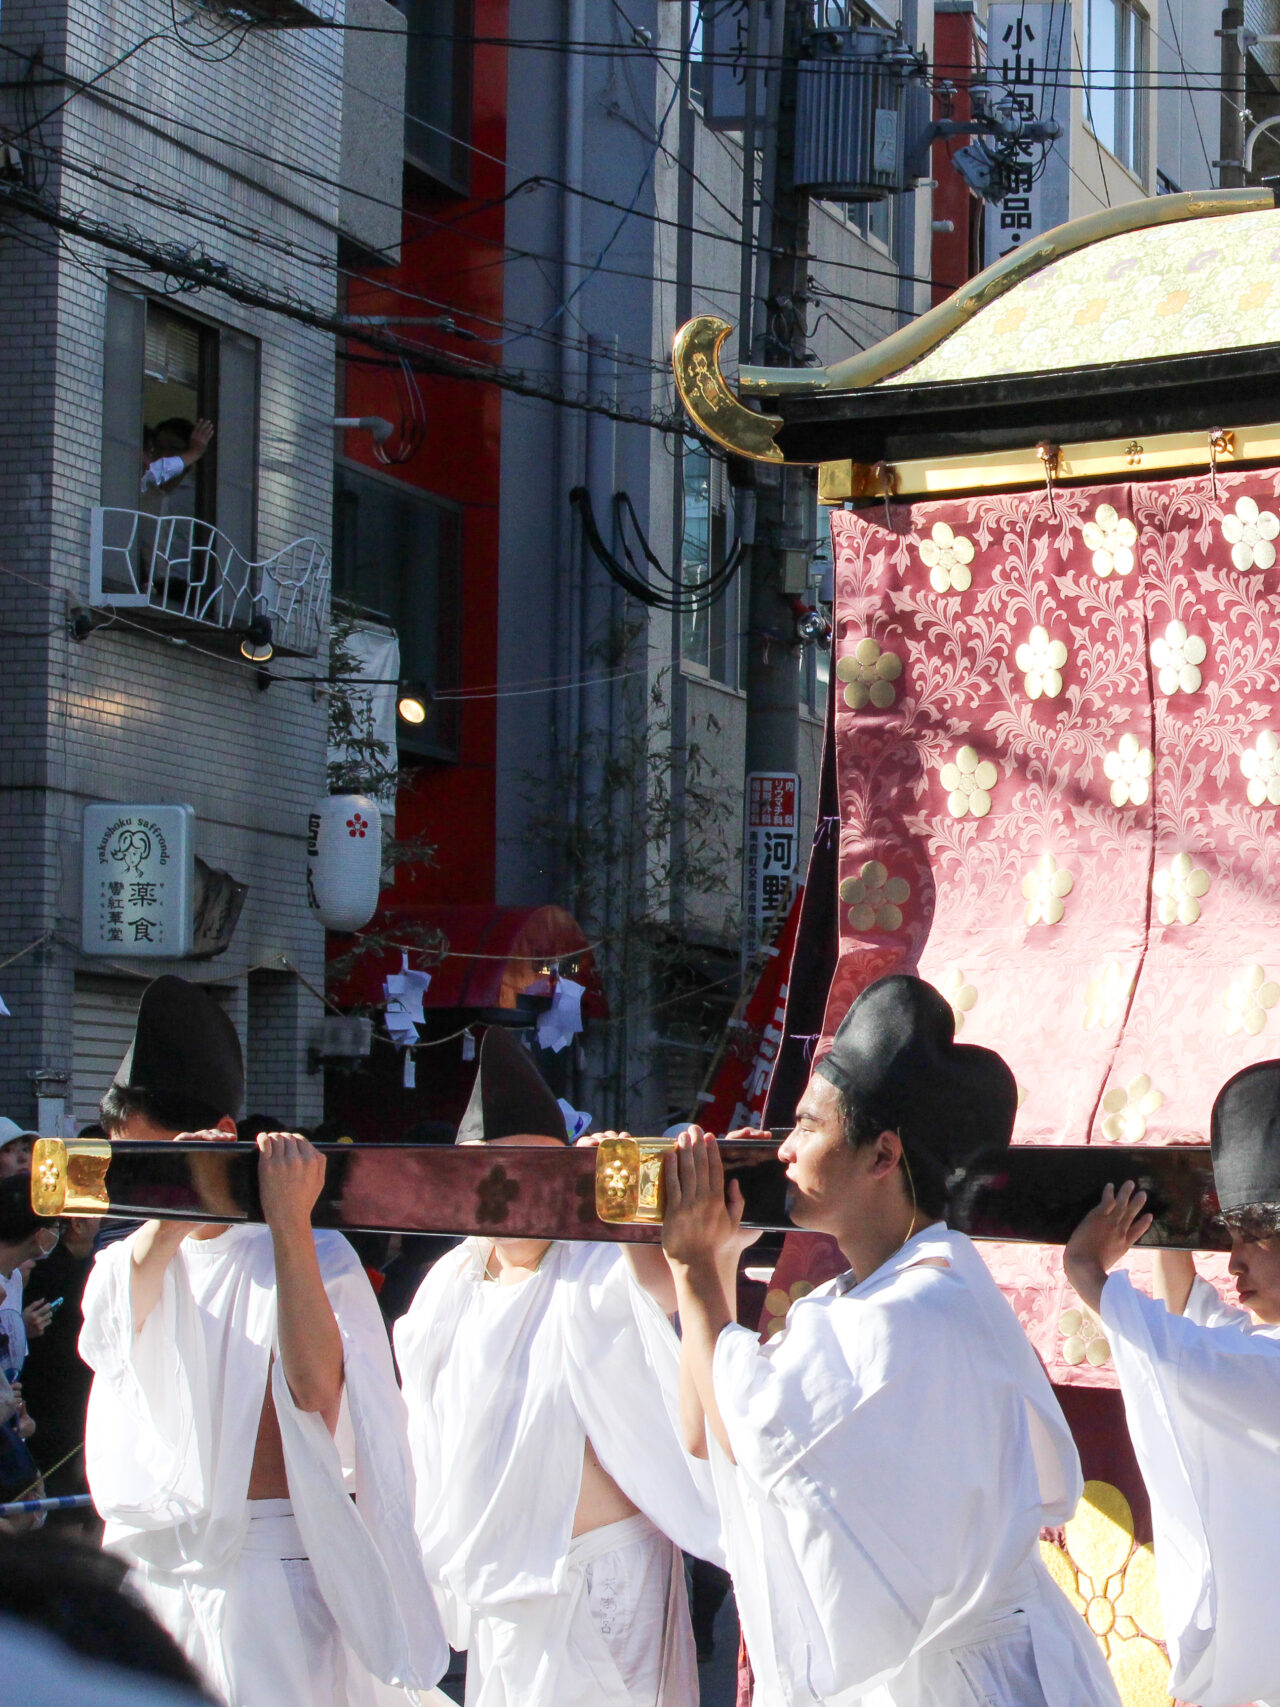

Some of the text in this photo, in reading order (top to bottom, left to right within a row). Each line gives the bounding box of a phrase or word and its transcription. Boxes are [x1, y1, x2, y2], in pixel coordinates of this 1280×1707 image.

[97, 817, 170, 866] yakushoku saffrondo
[128, 881, 157, 943] 薬食
